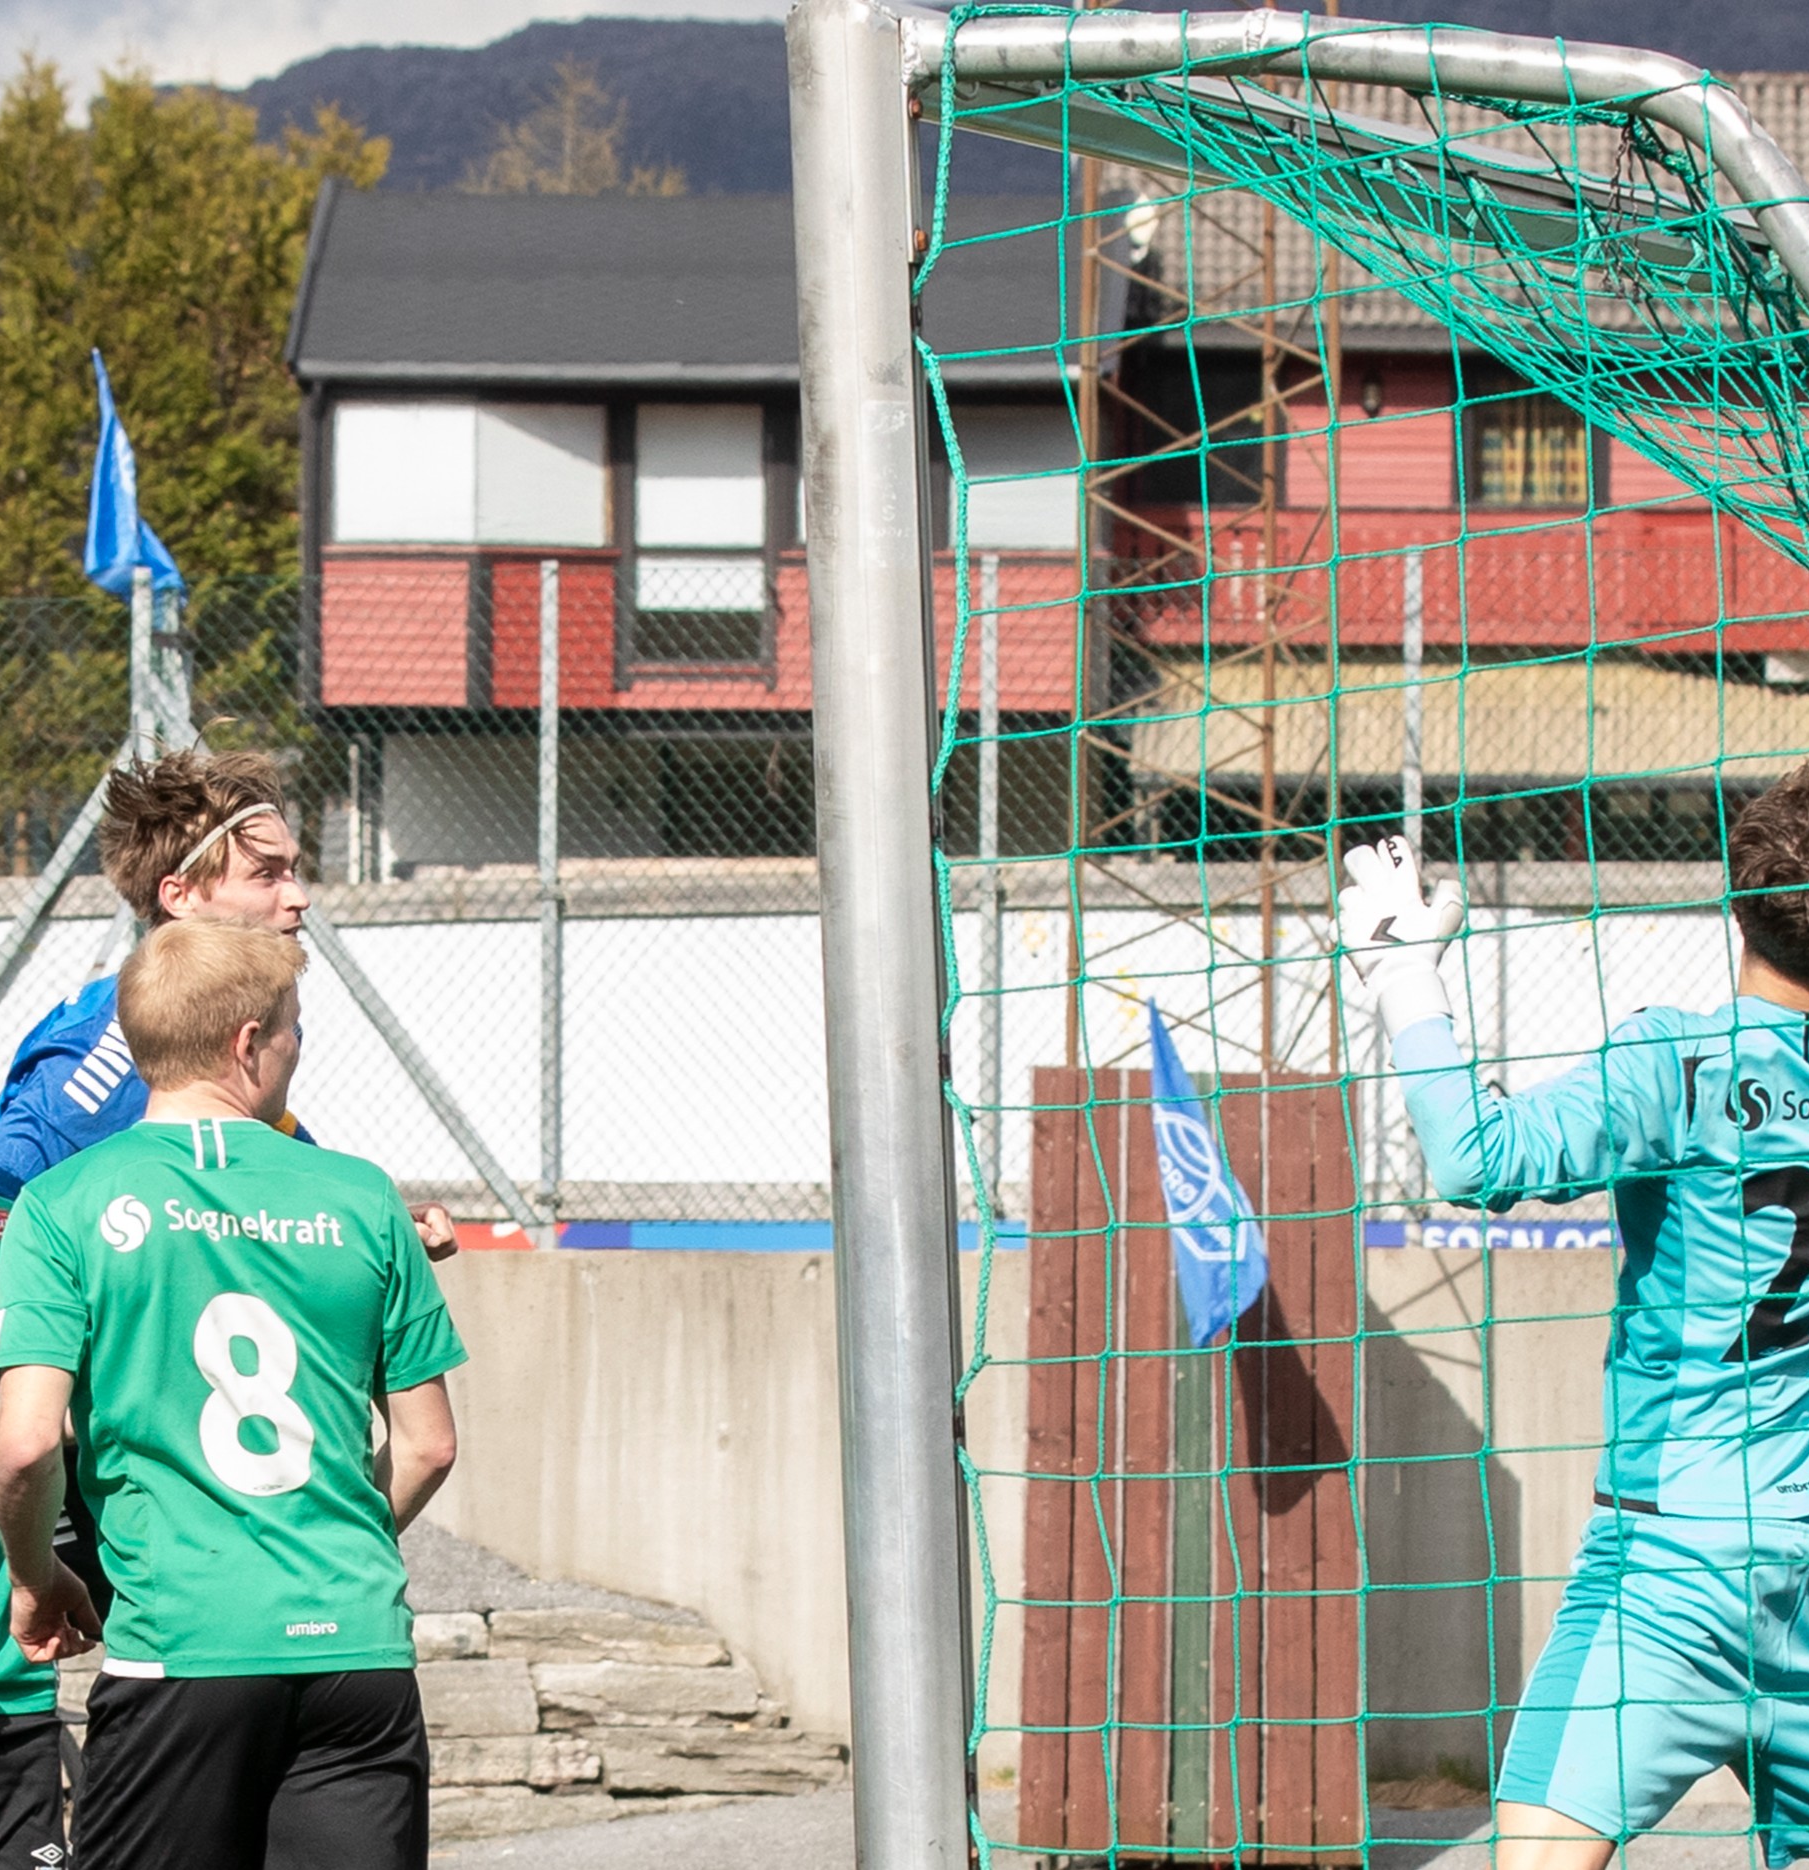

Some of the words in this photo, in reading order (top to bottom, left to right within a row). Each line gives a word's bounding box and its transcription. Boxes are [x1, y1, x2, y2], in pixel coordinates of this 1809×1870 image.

[163, 1198, 345, 1248] Sognekraft
[193, 1291, 315, 1497] 8
[285, 1621, 338, 1638] umbro
